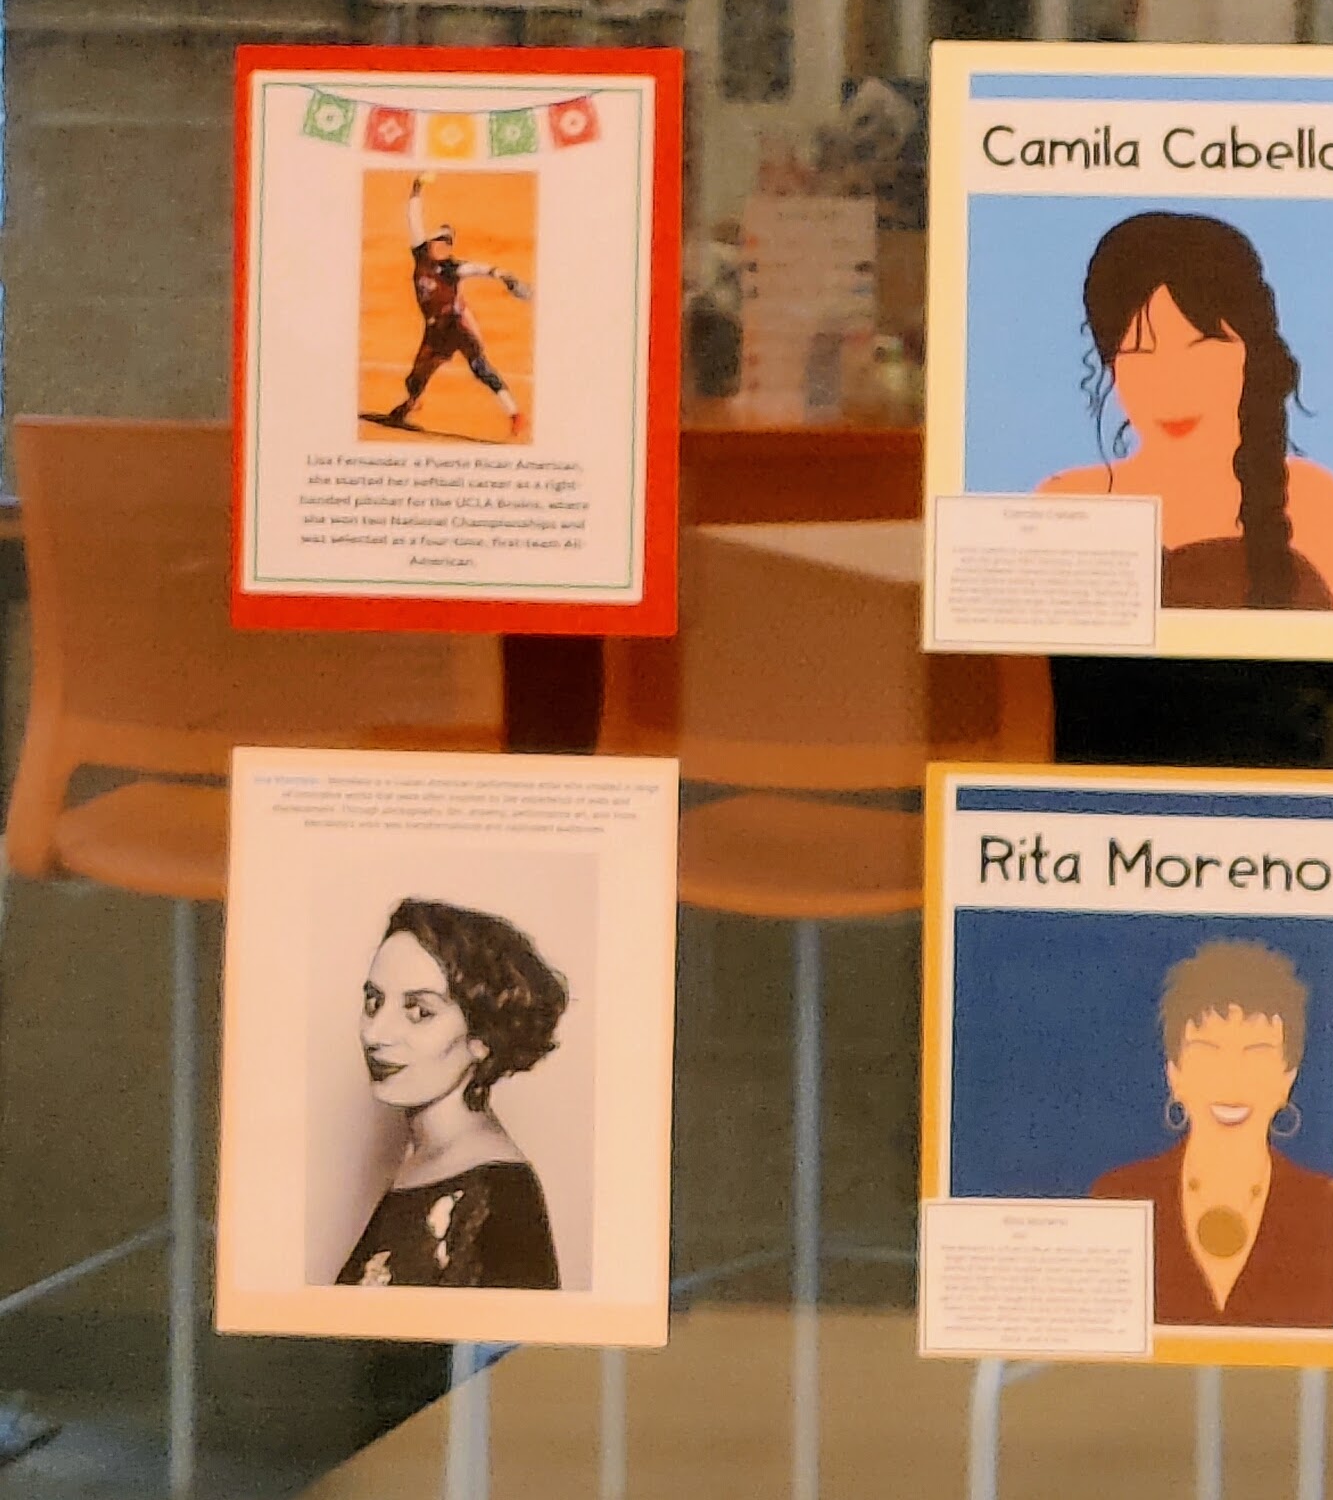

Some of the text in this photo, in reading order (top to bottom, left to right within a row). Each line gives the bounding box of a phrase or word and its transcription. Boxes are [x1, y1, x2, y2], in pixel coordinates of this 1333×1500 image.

[982, 124, 1140, 170] Camila
[455, 497, 492, 508] UCLA
[980, 835, 1332, 892] Rita Moreno
